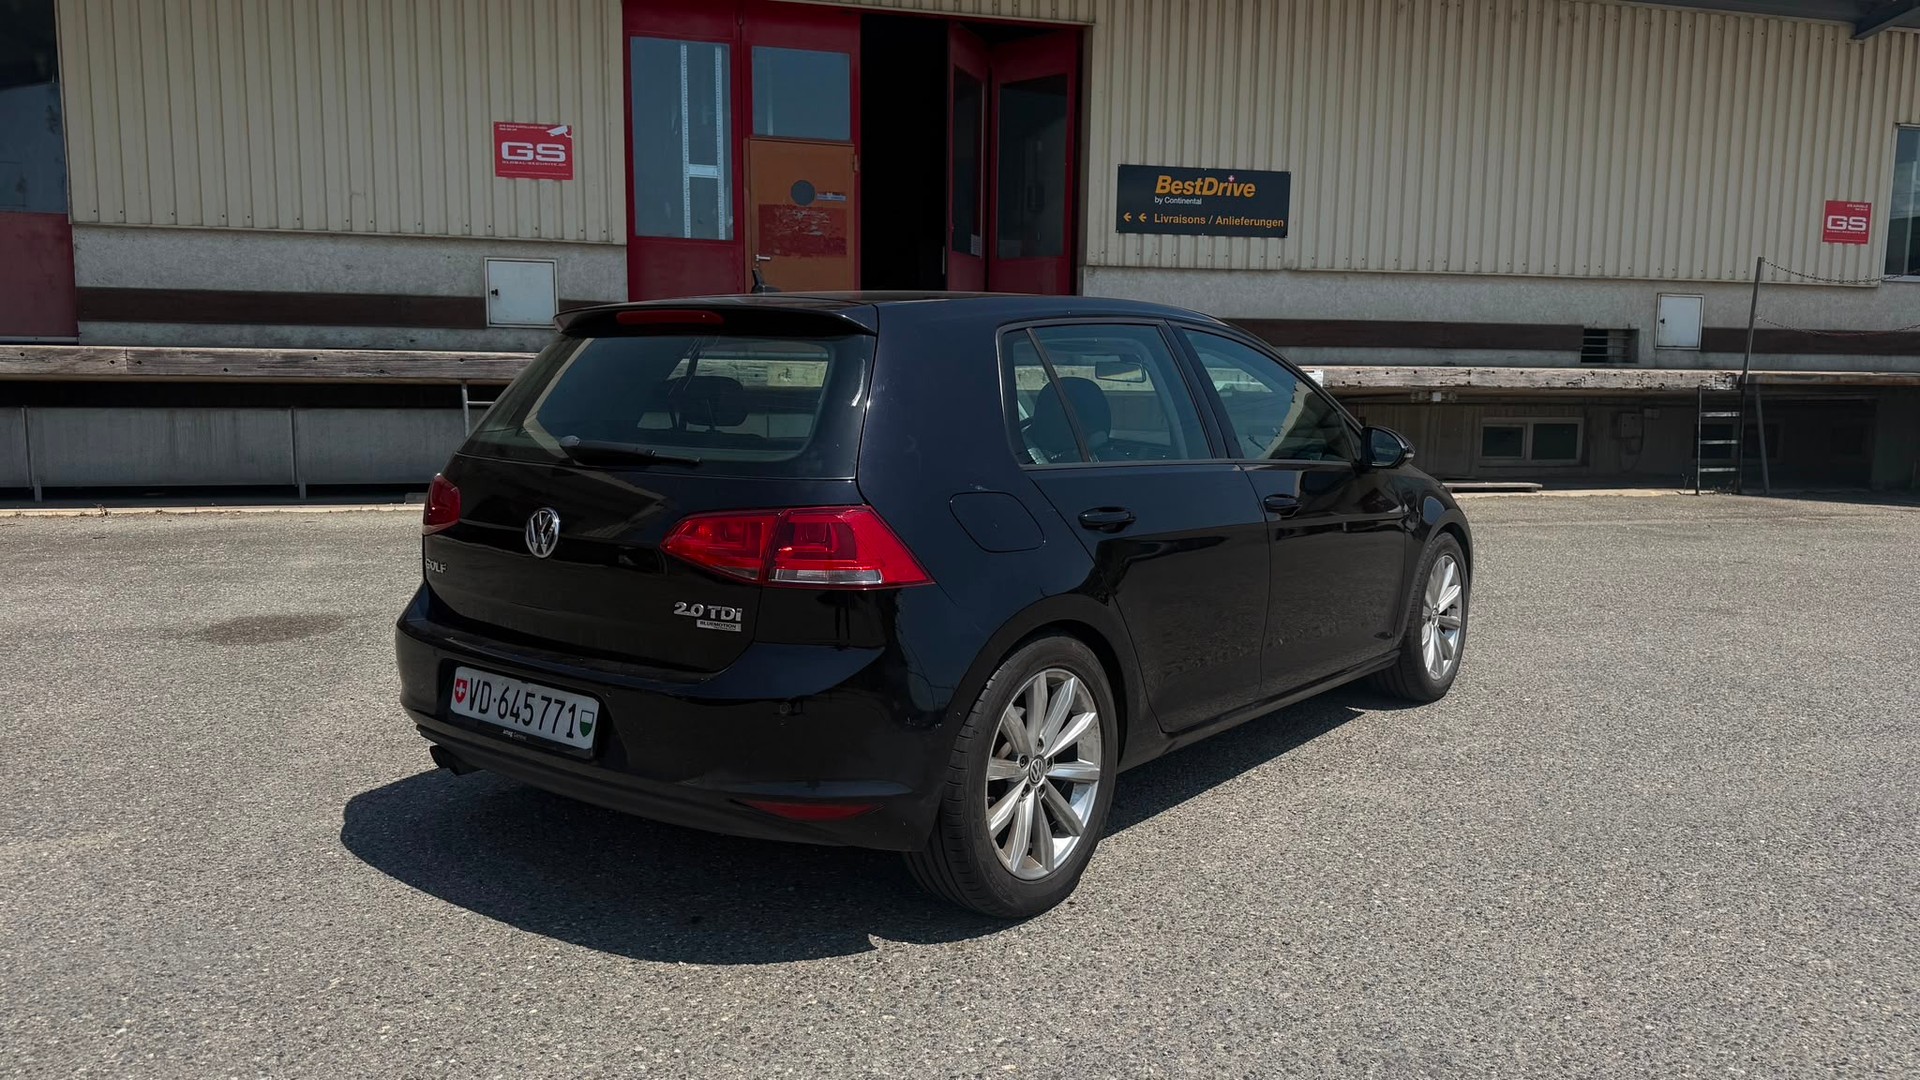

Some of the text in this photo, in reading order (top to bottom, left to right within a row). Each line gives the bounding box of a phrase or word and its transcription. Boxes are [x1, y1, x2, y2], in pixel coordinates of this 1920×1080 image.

[501, 141, 567, 162] GS
[1155, 174, 1256, 198] BestDrive
[1154, 196, 1202, 206] by Continental
[1154, 213, 1206, 225] Livraisons
[1215, 215, 1285, 229] Anlieferungen
[1826, 215, 1867, 232] GS
[426, 557, 447, 574] GOLF
